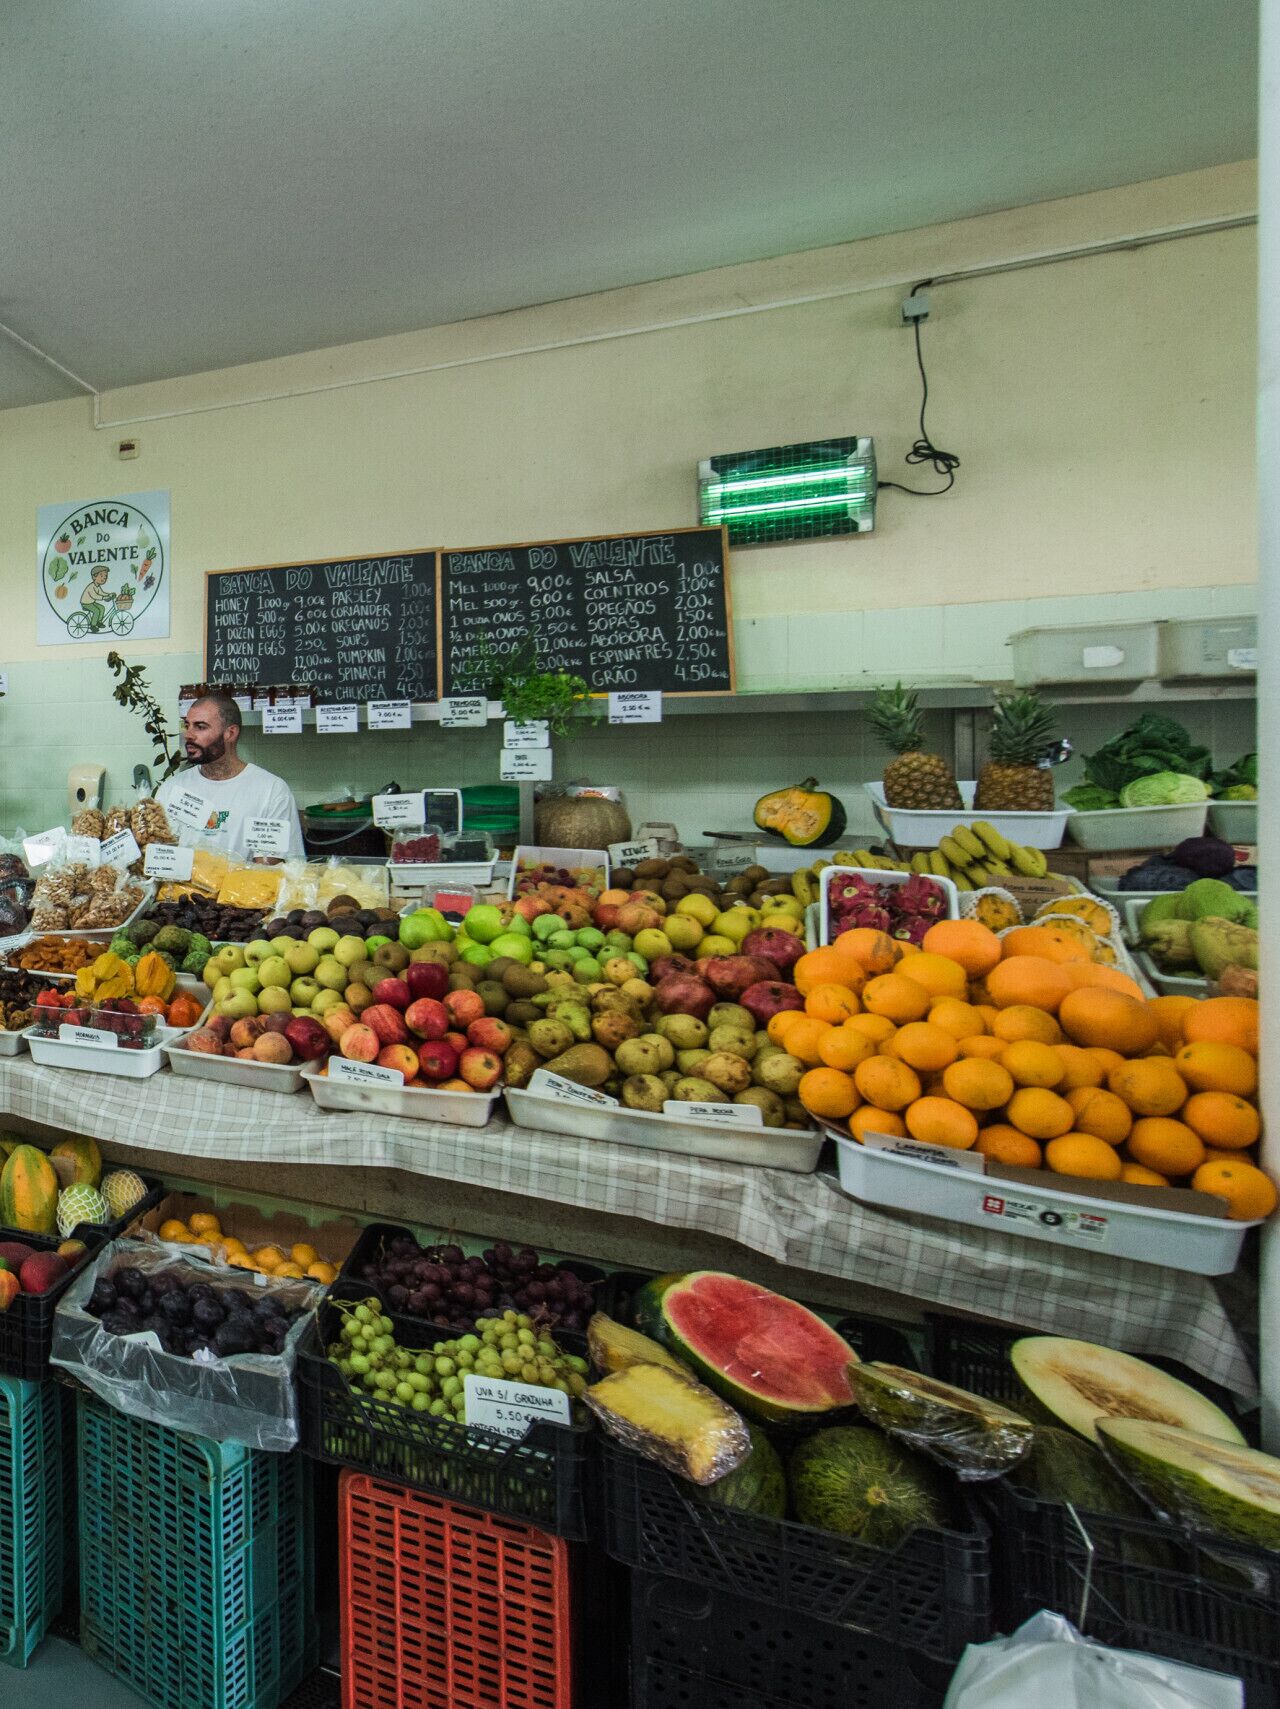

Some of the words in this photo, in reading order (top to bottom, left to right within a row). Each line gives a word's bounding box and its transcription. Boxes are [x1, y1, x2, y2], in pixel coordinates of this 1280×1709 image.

[70, 509, 129, 535] BANCA
[96, 532, 110, 543] DO
[68, 545, 139, 565] VALENTE
[449, 551, 515, 575] BANCA
[528, 546, 558, 570] DO
[569, 536, 676, 568] VALENTE
[220, 570, 275, 595] BANCA
[285, 567, 313, 591] DO
[324, 558, 414, 588] VALENTE
[584, 569, 636, 586] SALSA
[449, 581, 478, 595] MEL
[584, 581, 669, 600] COENTROS
[215, 597, 249, 612] HONEY
[332, 588, 381, 605] PARSLEY
[330, 603, 391, 619] CORIANDER
[449, 598, 478, 612] MEL
[215, 613, 249, 626] HONEY
[332, 618, 389, 633] OREGANOS
[492, 611, 526, 624] OVOS
[587, 615, 640, 632] SOPAS
[227, 627, 254, 640] DOZEN
[260, 625, 286, 639] EGGS
[495, 626, 528, 639] OVOS
[227, 643, 254, 656] DOZEN
[258, 641, 286, 656] EGGS
[336, 633, 369, 649] SOUPS
[337, 648, 386, 664] PUMPKIN
[590, 643, 672, 665] ESPINAFRES
[213, 657, 260, 671] ALMOND
[338, 666, 386, 682] SPINACH
[592, 665, 637, 686] GRÃO
[621, 845, 650, 856] KIWI
[475, 1386, 493, 1396] UVA
[514, 1393, 553, 1407] GRAINHA
